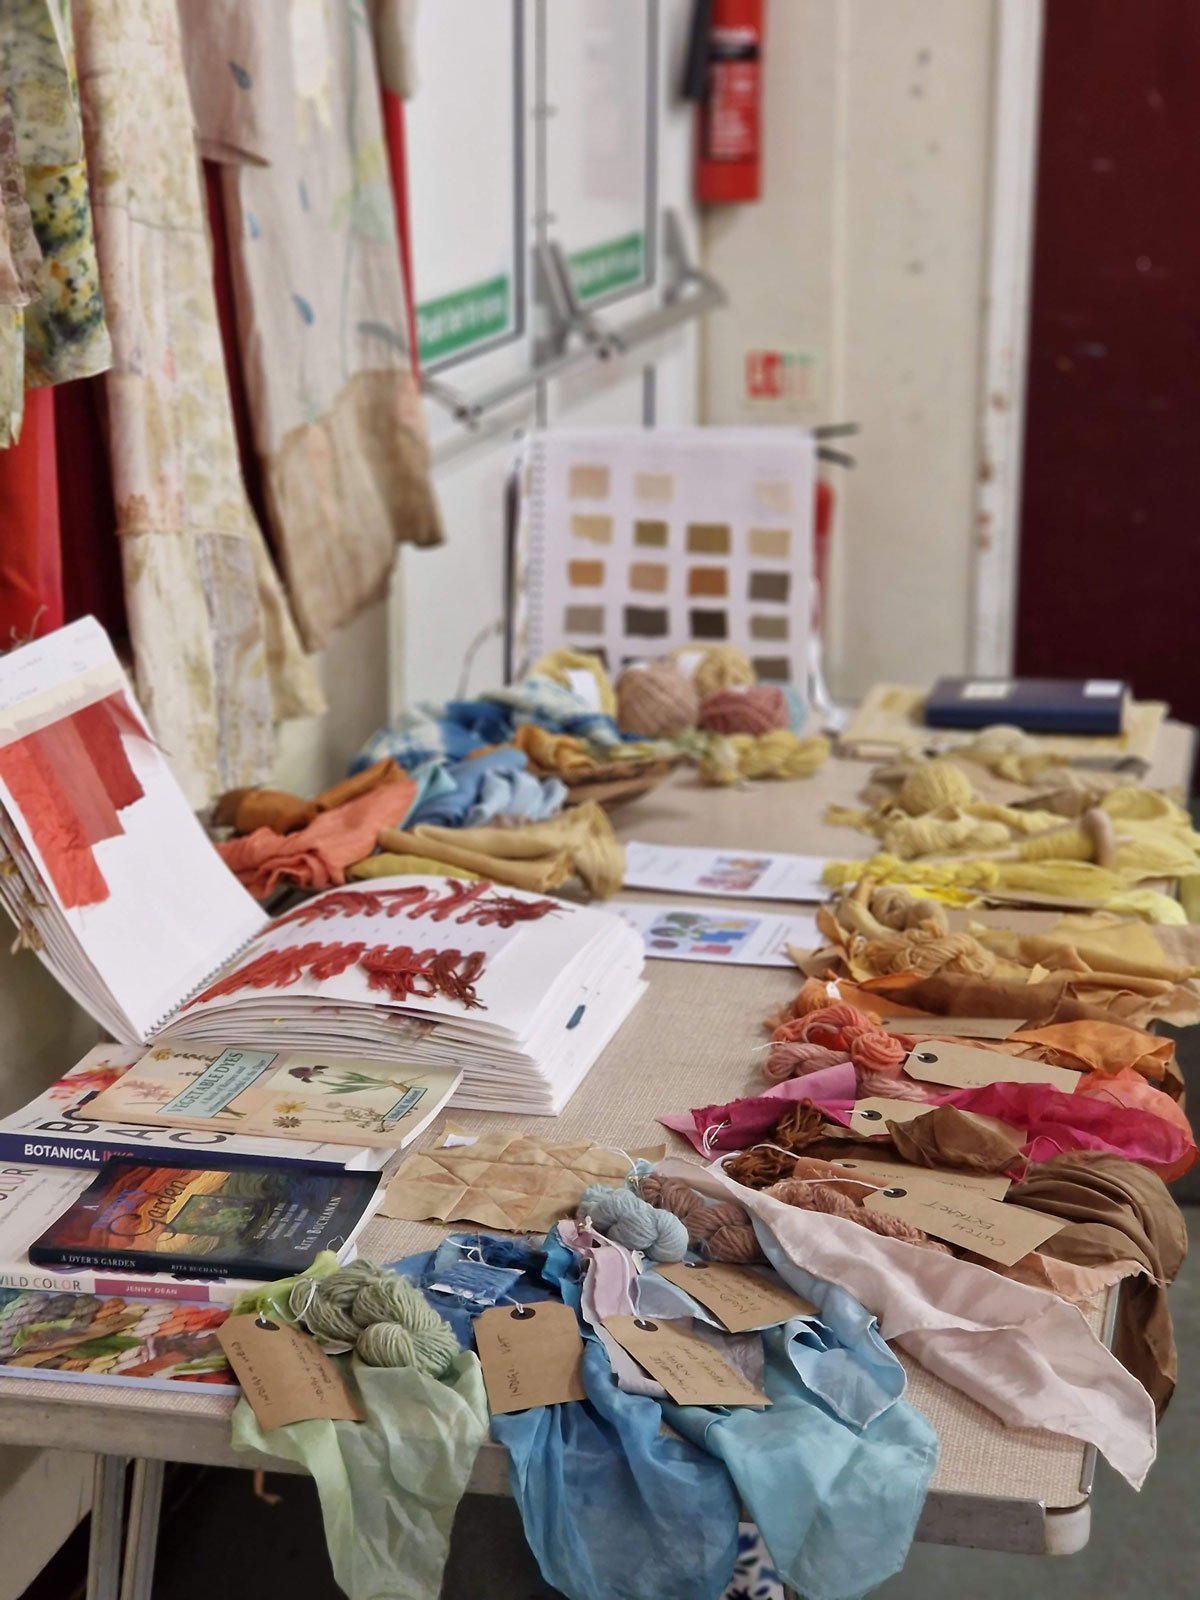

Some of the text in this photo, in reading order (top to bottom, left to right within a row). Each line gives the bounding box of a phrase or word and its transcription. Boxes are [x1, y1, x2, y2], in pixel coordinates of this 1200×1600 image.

[167, 1051, 244, 1113] VEGETABLE DYES
[24, 1143, 100, 1162] BOTANICAL
[108, 1180, 190, 1241] Garden
[920, 1200, 995, 1230] EXTRACT
[952, 1222, 1006, 1247] CUTCH
[61, 1255, 136, 1268] A DYER'S GARDEN
[171, 1264, 229, 1275] RITA BUCHANAN
[33, 1277, 82, 1291] COLOR
[125, 1286, 178, 1295] JENNY DEAN
